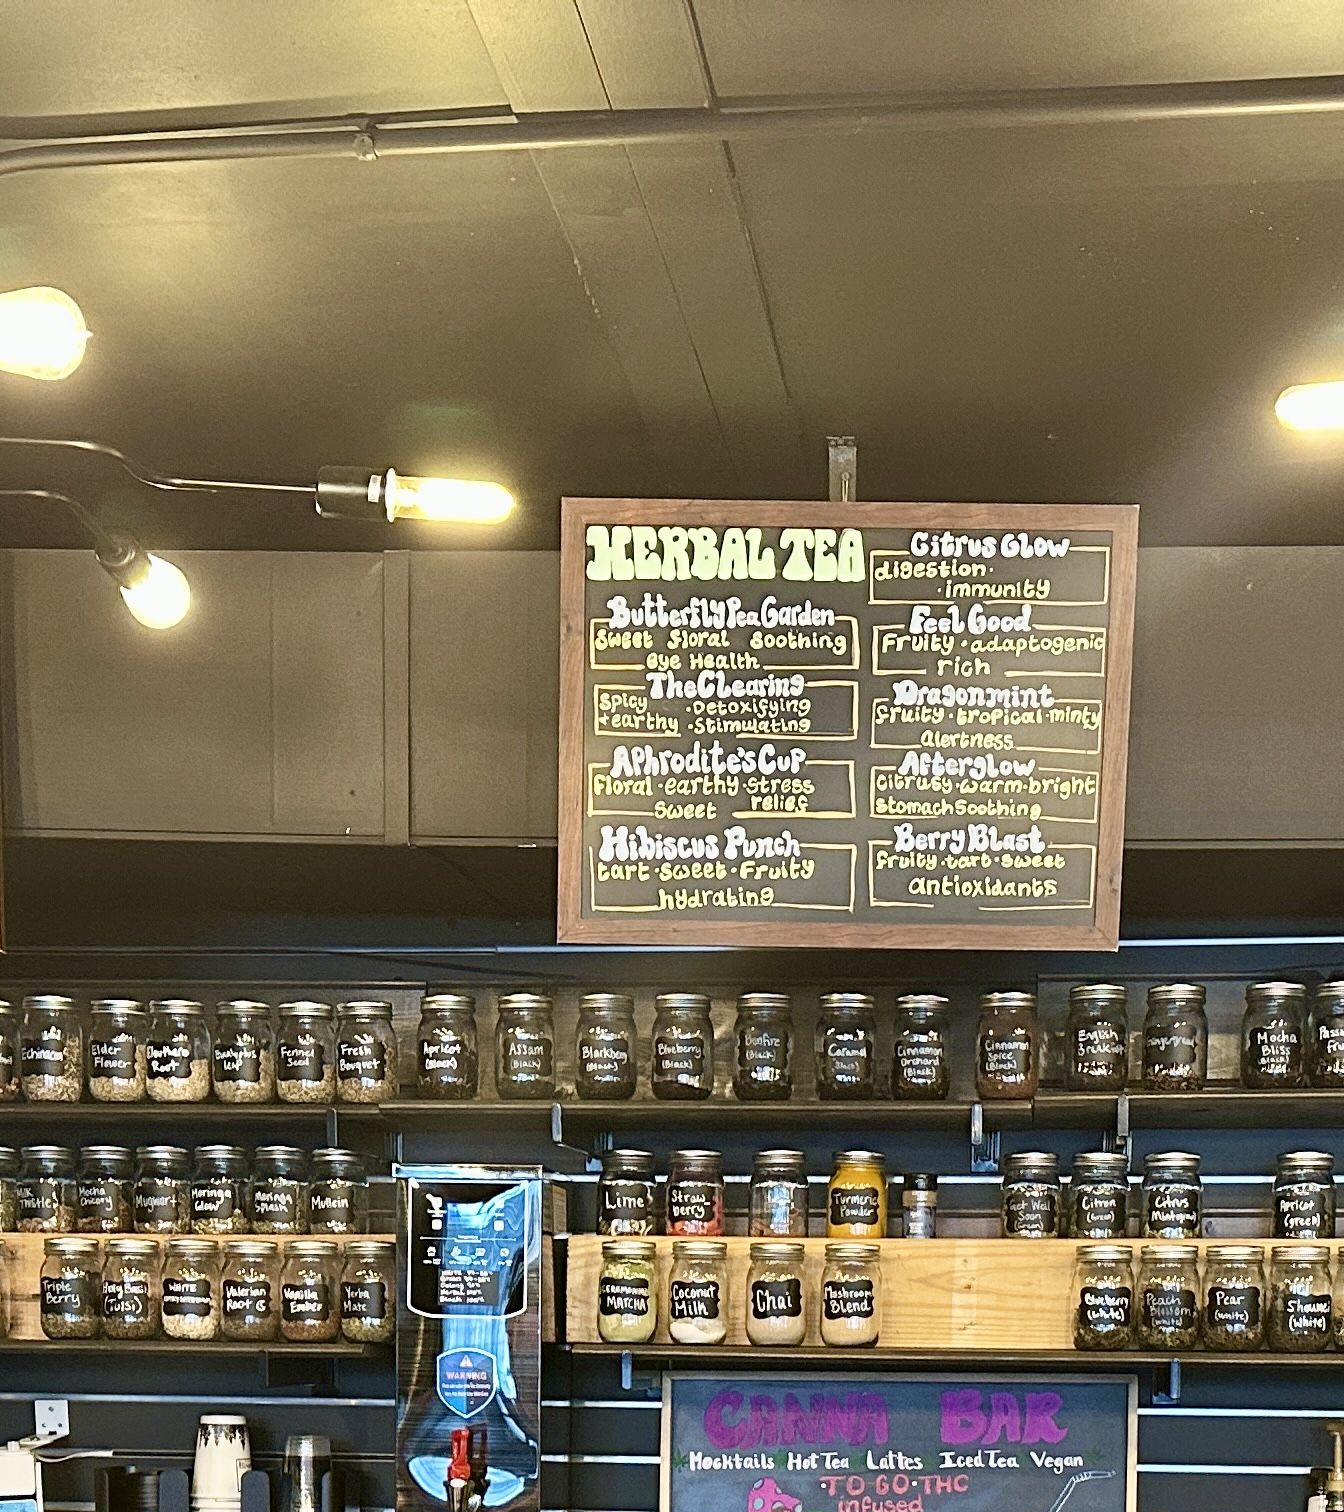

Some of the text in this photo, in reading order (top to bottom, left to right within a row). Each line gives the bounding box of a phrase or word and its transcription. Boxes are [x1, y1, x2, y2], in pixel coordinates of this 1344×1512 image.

[586, 525, 865, 581] HERBAL TEA
[910, 531, 1070, 558] Citrus Glow
[874, 559, 986, 581] digestion
[946, 579, 1050, 599] immunity
[761, 596, 835, 628] Garden
[909, 603, 1032, 635] Feel Good
[971, 634, 1105, 657] adaptogenic
[937, 656, 990, 677] rich
[697, 669, 804, 698] Clearing
[893, 680, 1055, 708] Dragonmint
[957, 709, 1042, 725] tropical
[898, 751, 1036, 780] Afterglow
[665, 776, 739, 795] earthy
[1029, 776, 1096, 799] bright
[599, 825, 801, 861] Hibiscus Punch
[894, 823, 1045, 854] Berry Blast
[598, 862, 650, 881] tart
[908, 875, 1058, 897] antioxidants
[658, 886, 774, 910] hydrating
[605, 1191, 645, 1209] Lime
[673, 1285, 717, 1299] Coconut
[756, 1290, 793, 1313] Chai
[704, 1389, 1067, 1450] CANNA BAR
[688, 1450, 1083, 1473] Mocktails Hot Tea Lattes Iced Tea Vegan
[918, 1475, 969, 1494] THC
